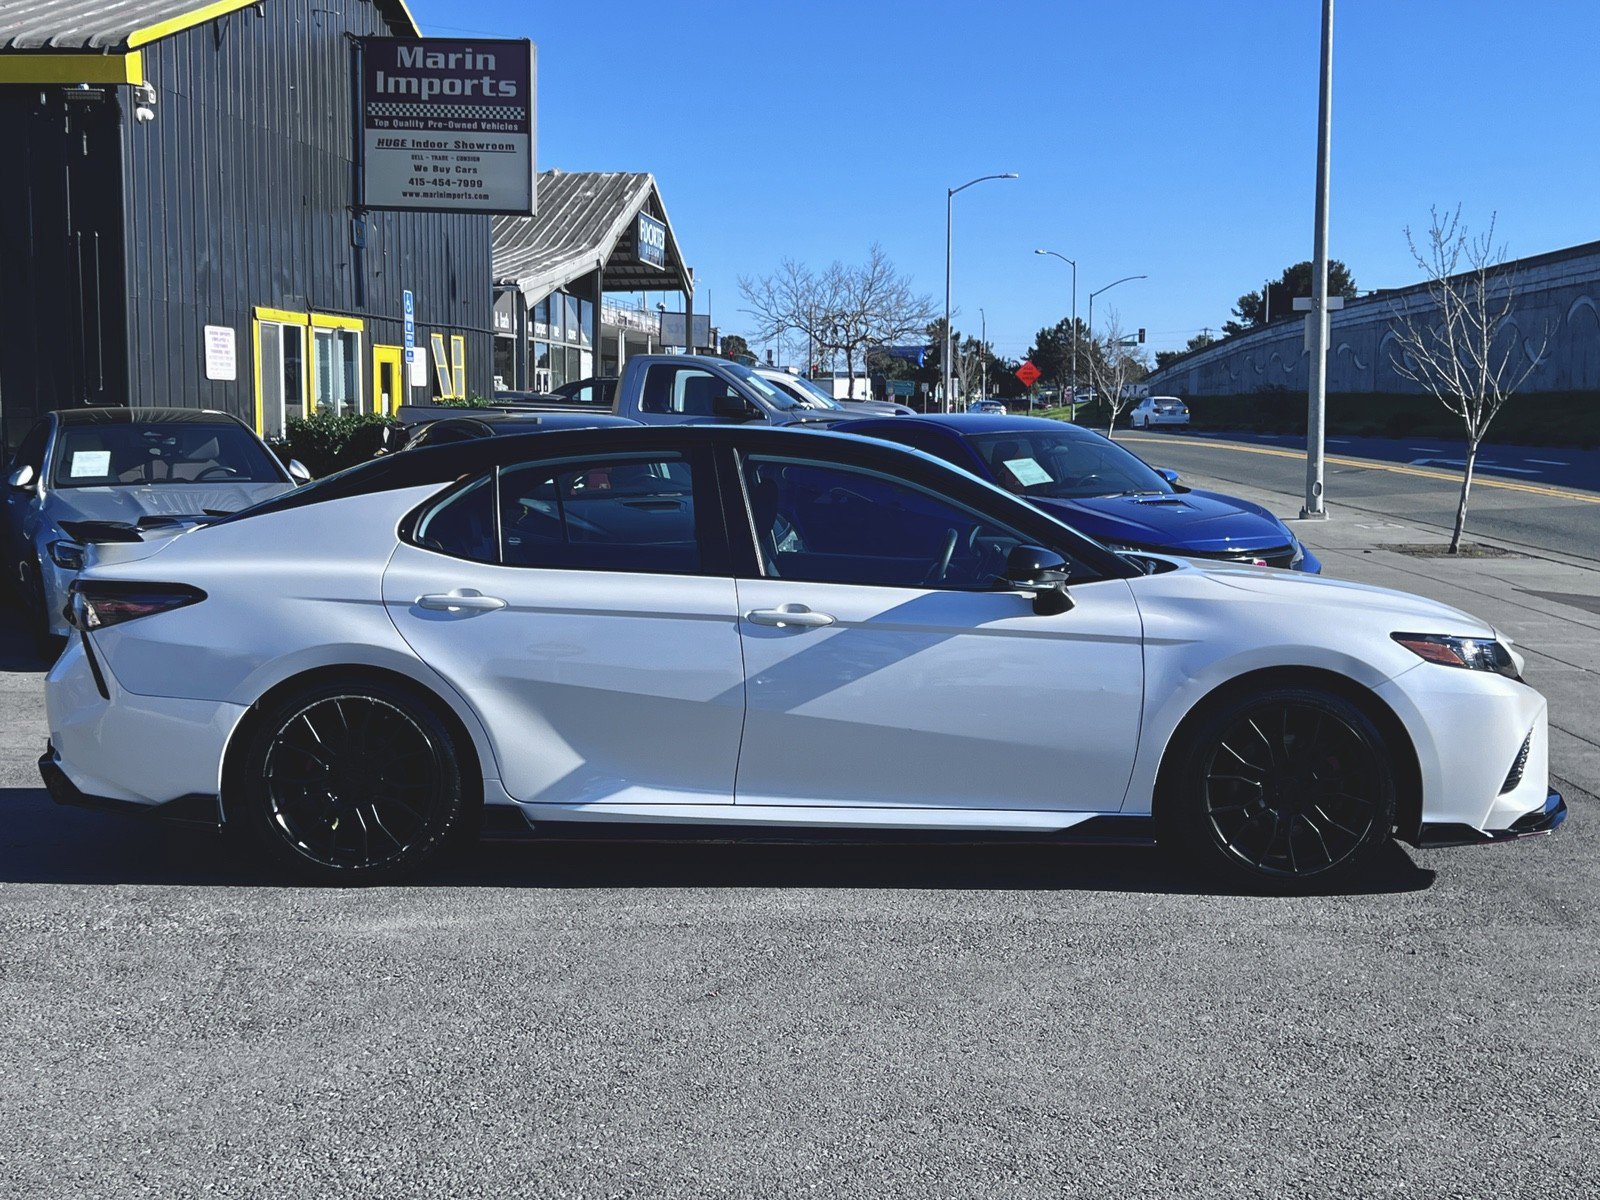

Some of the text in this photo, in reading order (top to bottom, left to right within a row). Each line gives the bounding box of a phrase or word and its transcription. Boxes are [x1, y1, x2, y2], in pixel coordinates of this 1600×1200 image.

[397, 46, 496, 70] Marin
[376, 71, 517, 101] Imports
[374, 119, 518, 131] Top Quality Pre-Owned Vehicles
[377, 138, 515, 151] HUGE Indoor Showroom
[413, 164, 478, 174] We Buy Cars
[408, 177, 483, 188] 415-454-7999
[402, 190, 490, 201] www.marinimports.com
